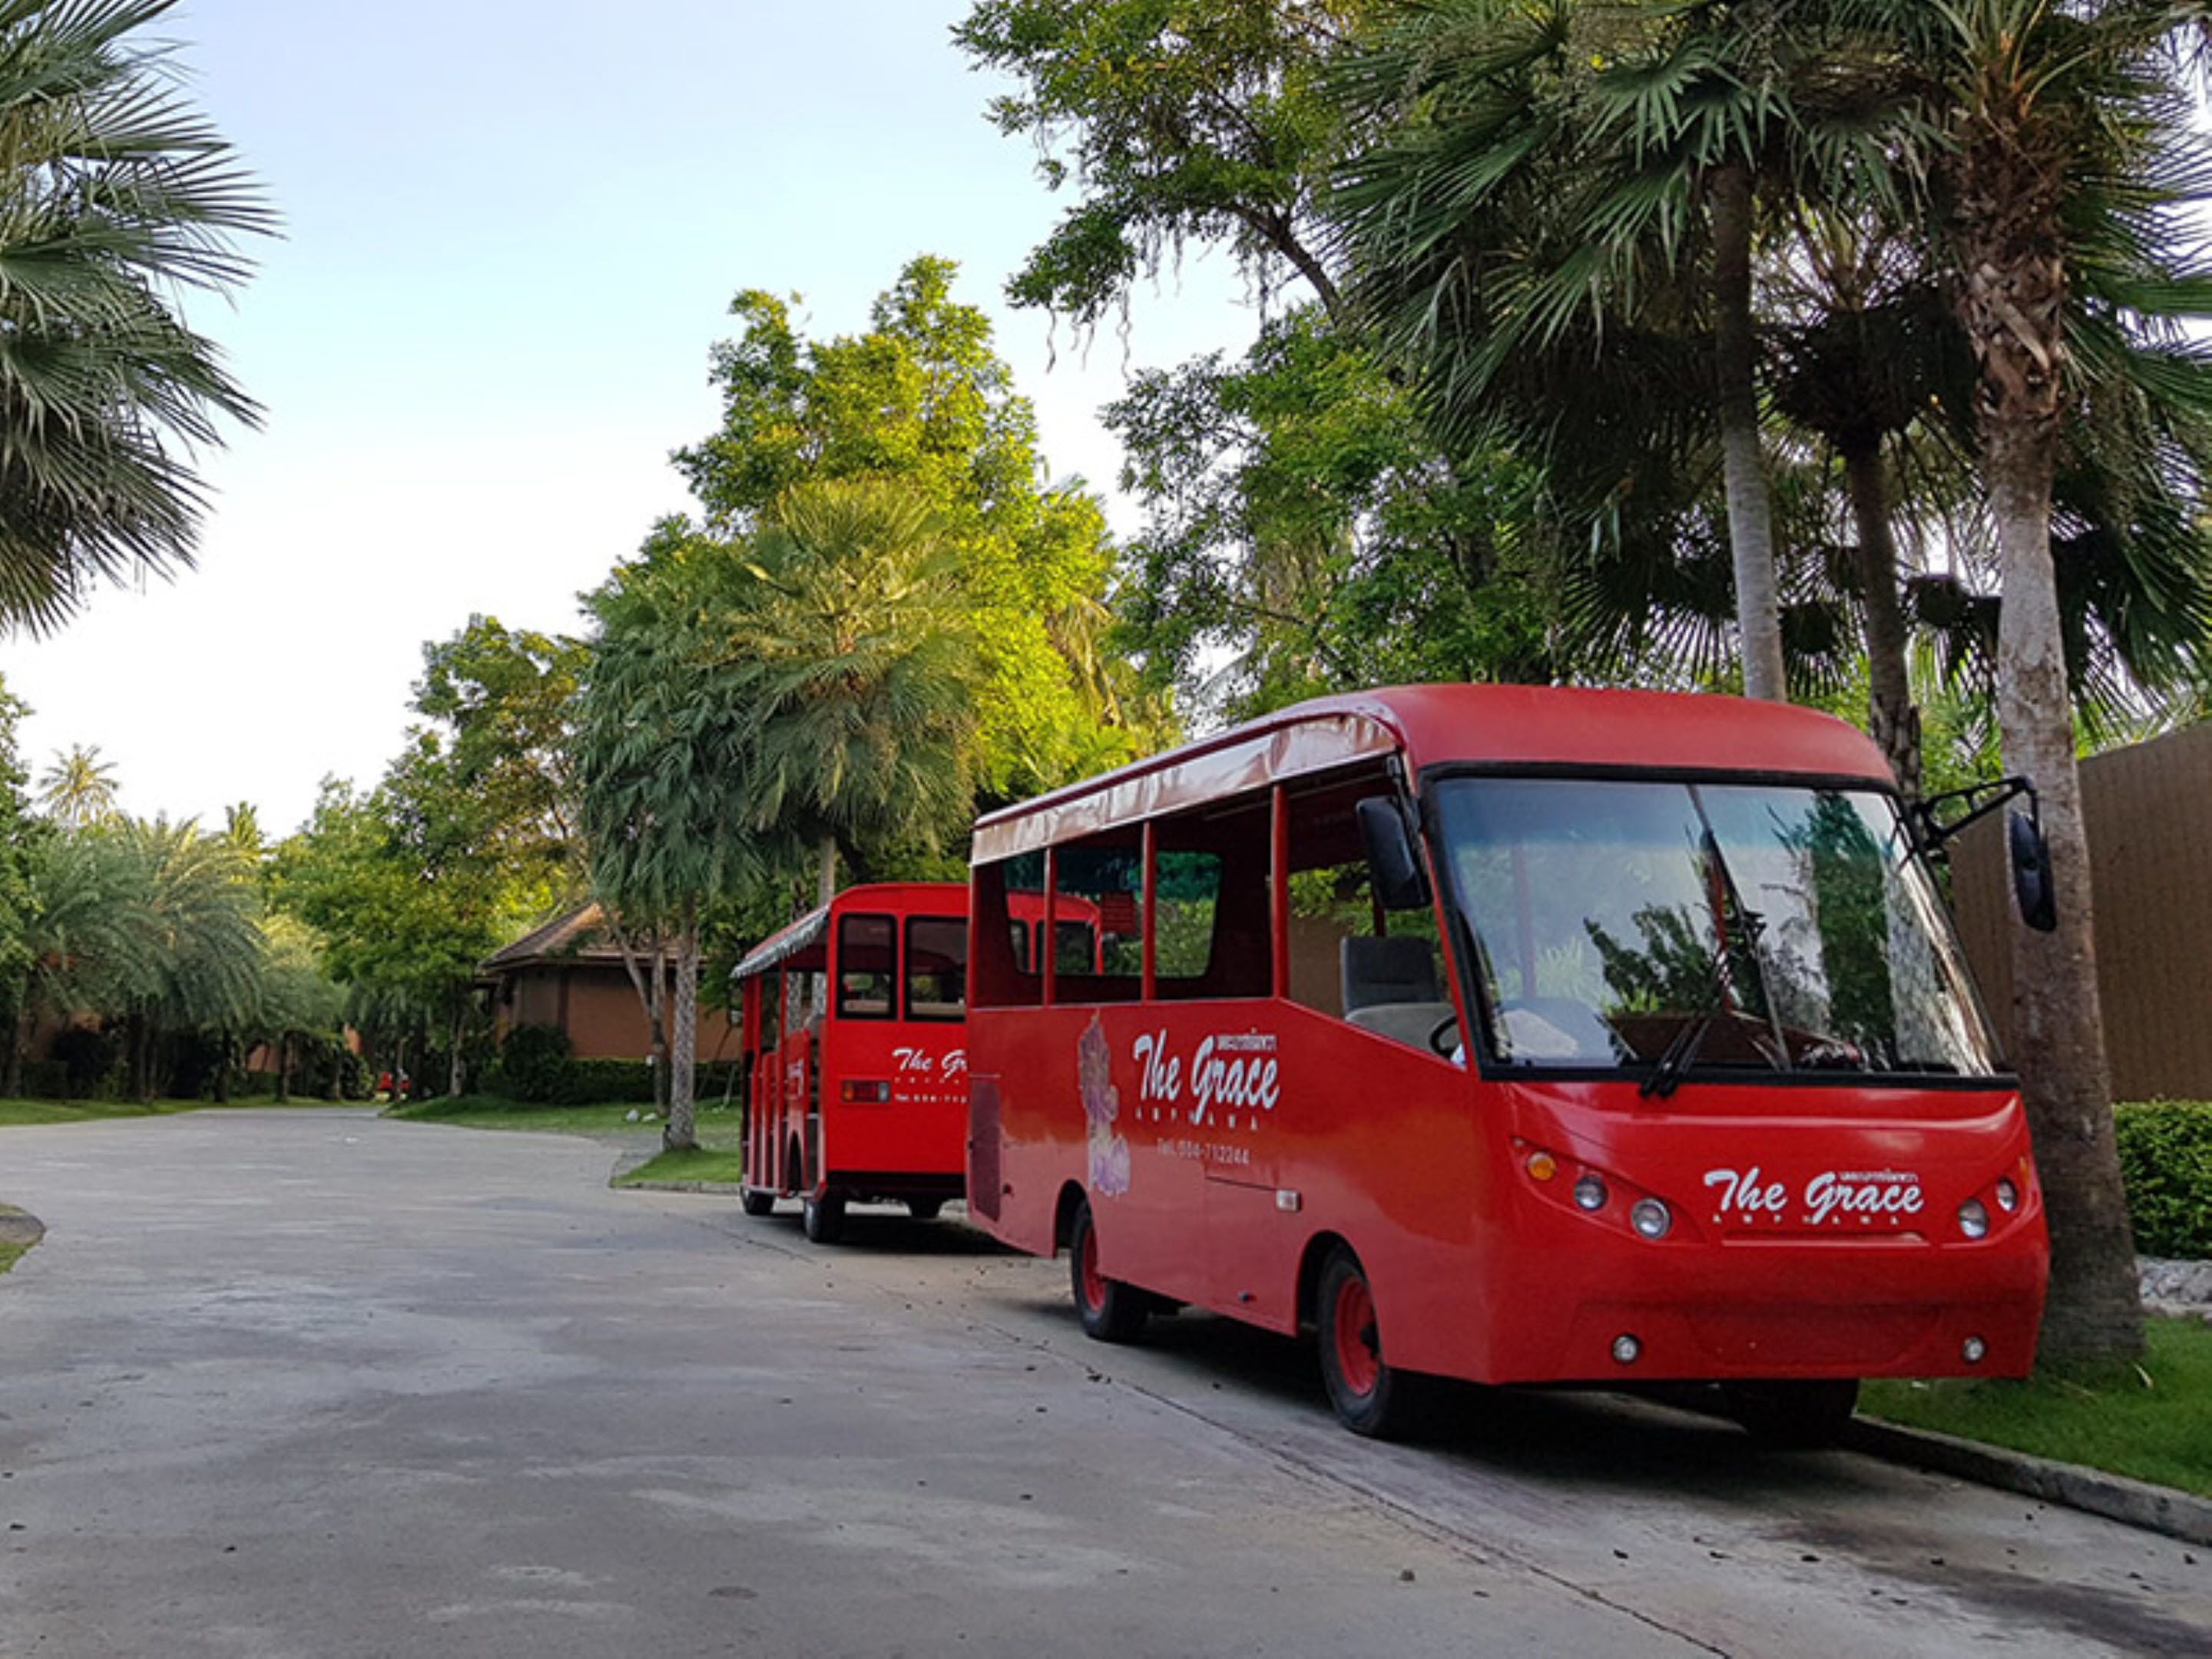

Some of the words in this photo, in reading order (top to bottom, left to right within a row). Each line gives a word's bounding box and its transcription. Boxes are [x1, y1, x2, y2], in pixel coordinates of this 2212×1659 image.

[892, 1046, 934, 1072] The
[1133, 1027, 1182, 1102] The
[1190, 1034, 1280, 1126] Grace
[1704, 1166, 1788, 1211] The
[1804, 1171, 1924, 1224] Grace
